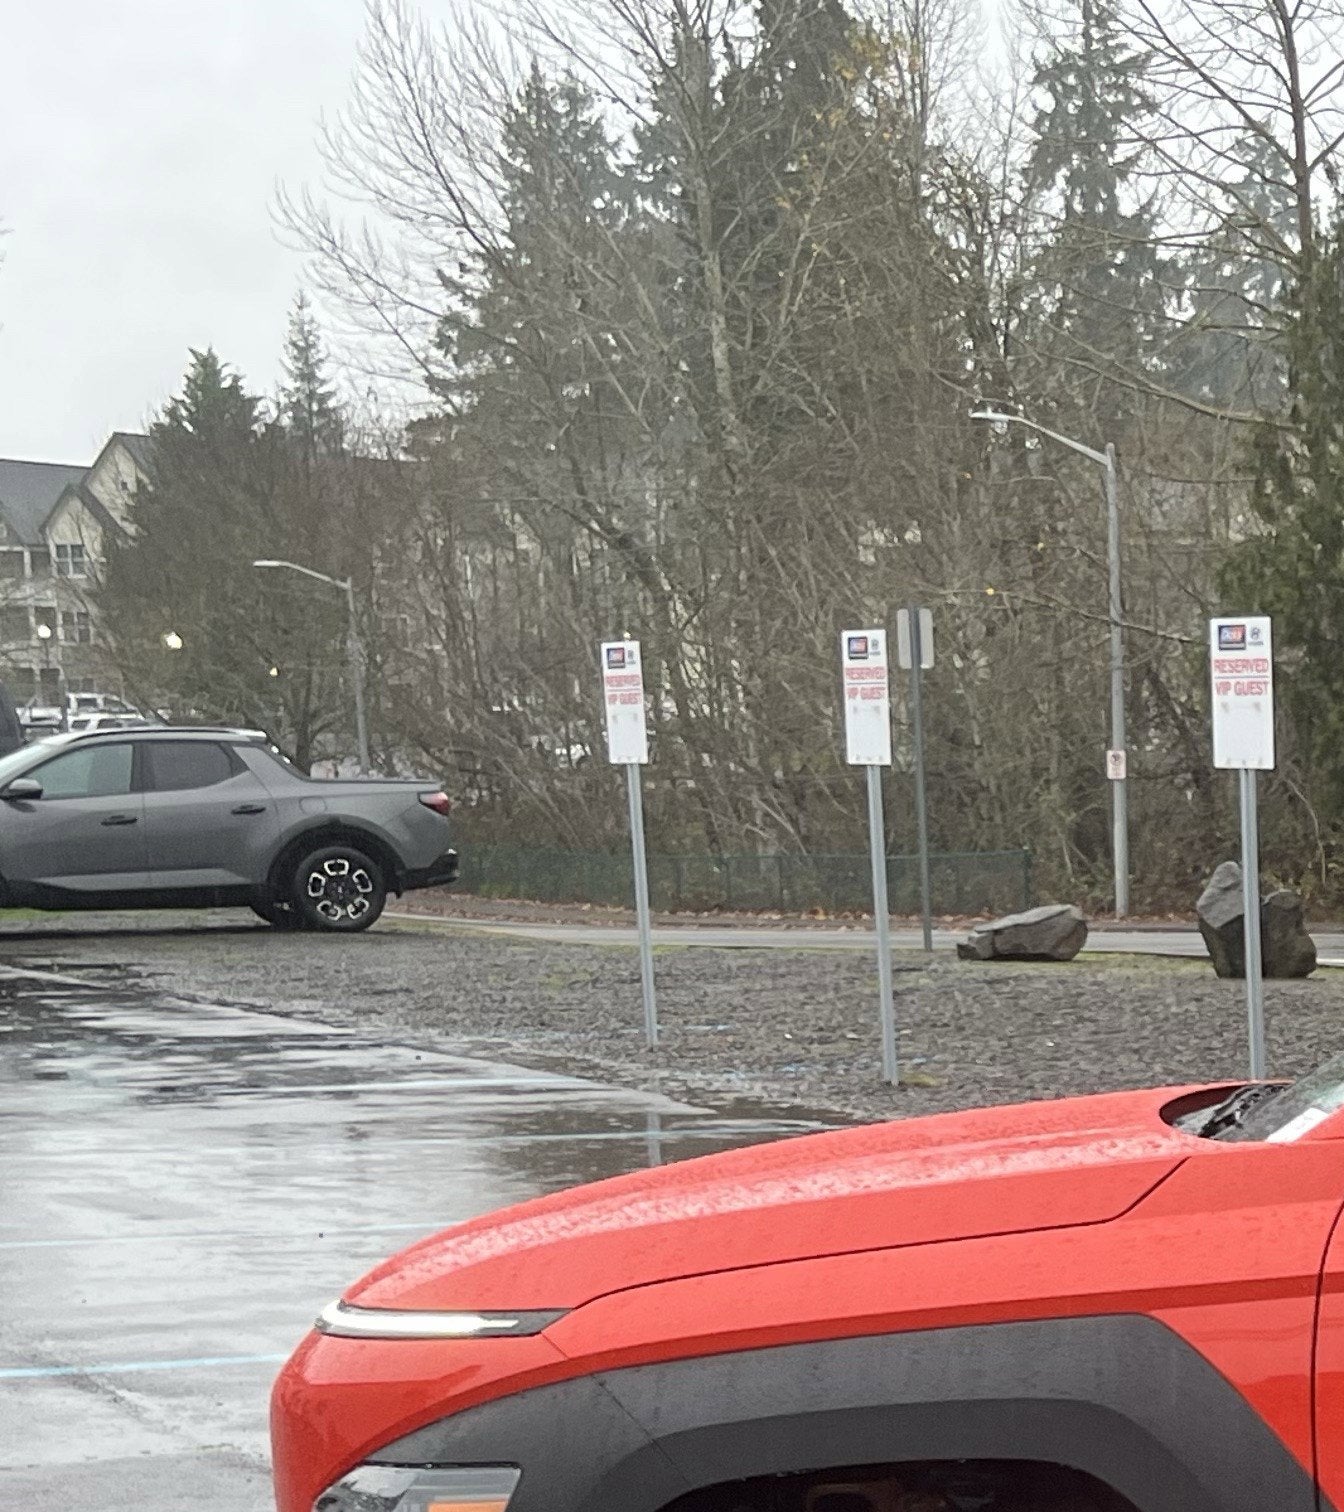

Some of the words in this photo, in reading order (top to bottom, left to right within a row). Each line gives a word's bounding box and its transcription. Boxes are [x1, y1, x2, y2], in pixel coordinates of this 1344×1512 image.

[1214, 658, 1269, 674] RESERVED
[1215, 681, 1231, 696] VIP
[1234, 681, 1269, 696] GUEST
